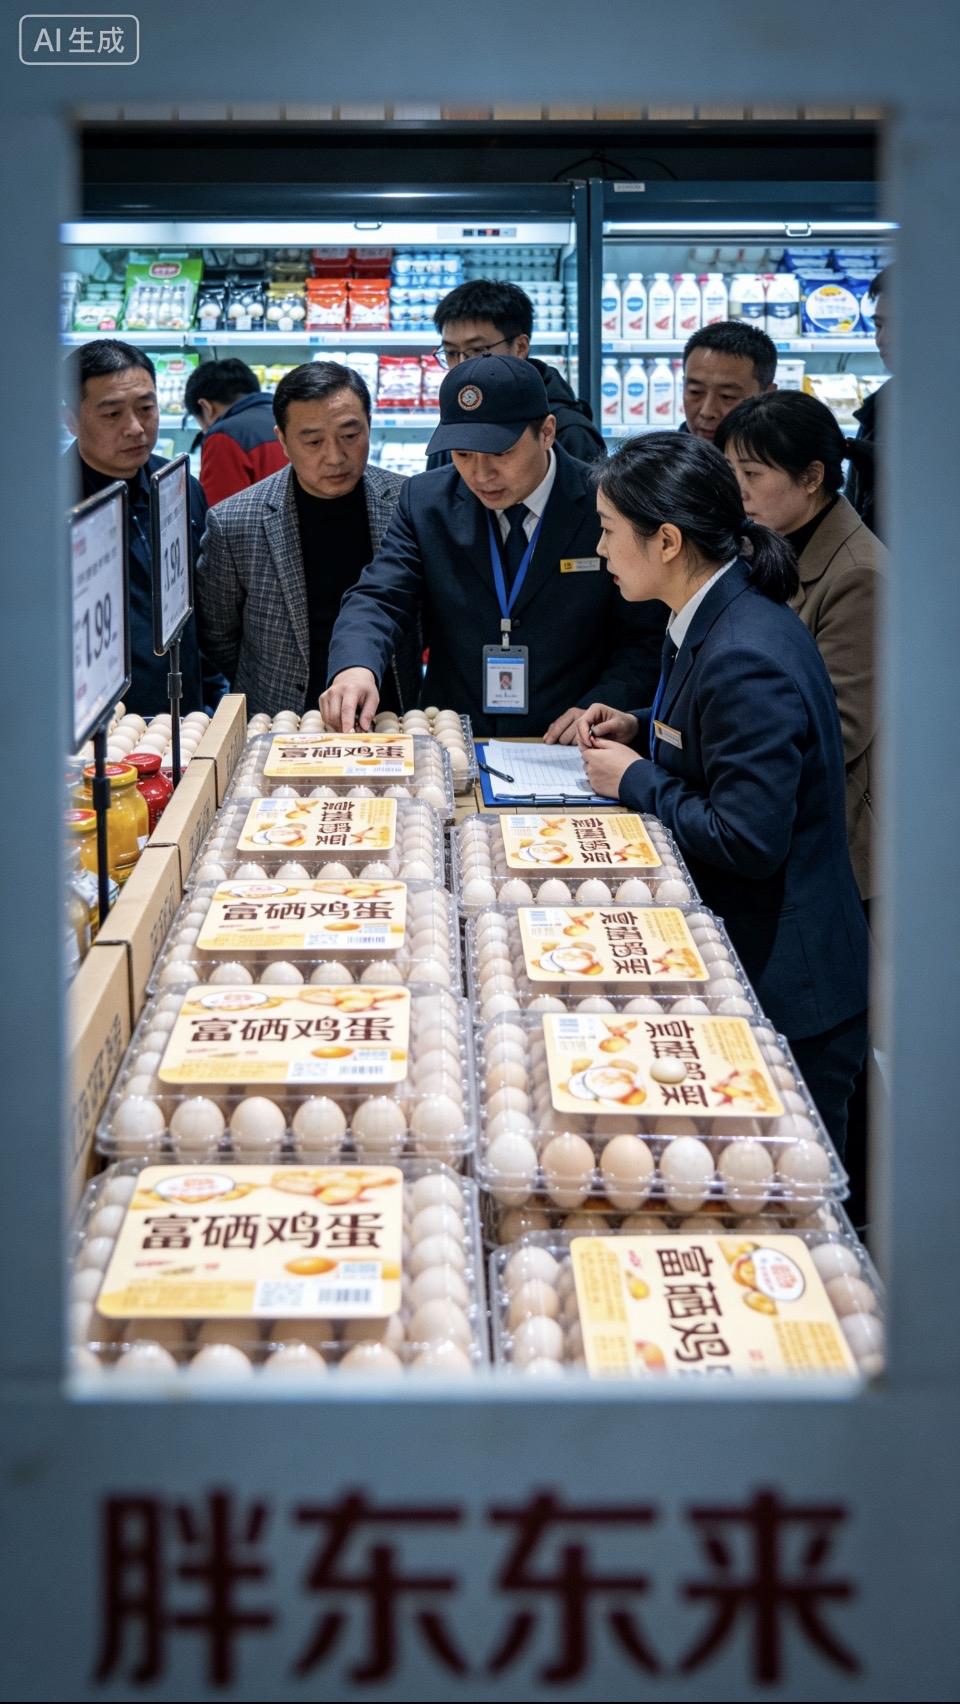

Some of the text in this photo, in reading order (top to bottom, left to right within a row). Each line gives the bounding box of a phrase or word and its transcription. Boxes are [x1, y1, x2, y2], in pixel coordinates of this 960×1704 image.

[221, 900, 396, 921] 富硒鸡蛋
[191, 1016, 395, 1043] 富硒鸡蛋
[141, 1210, 384, 1251] 富硒鸡蛋
[93, 1486, 863, 1690] 胖东东来
